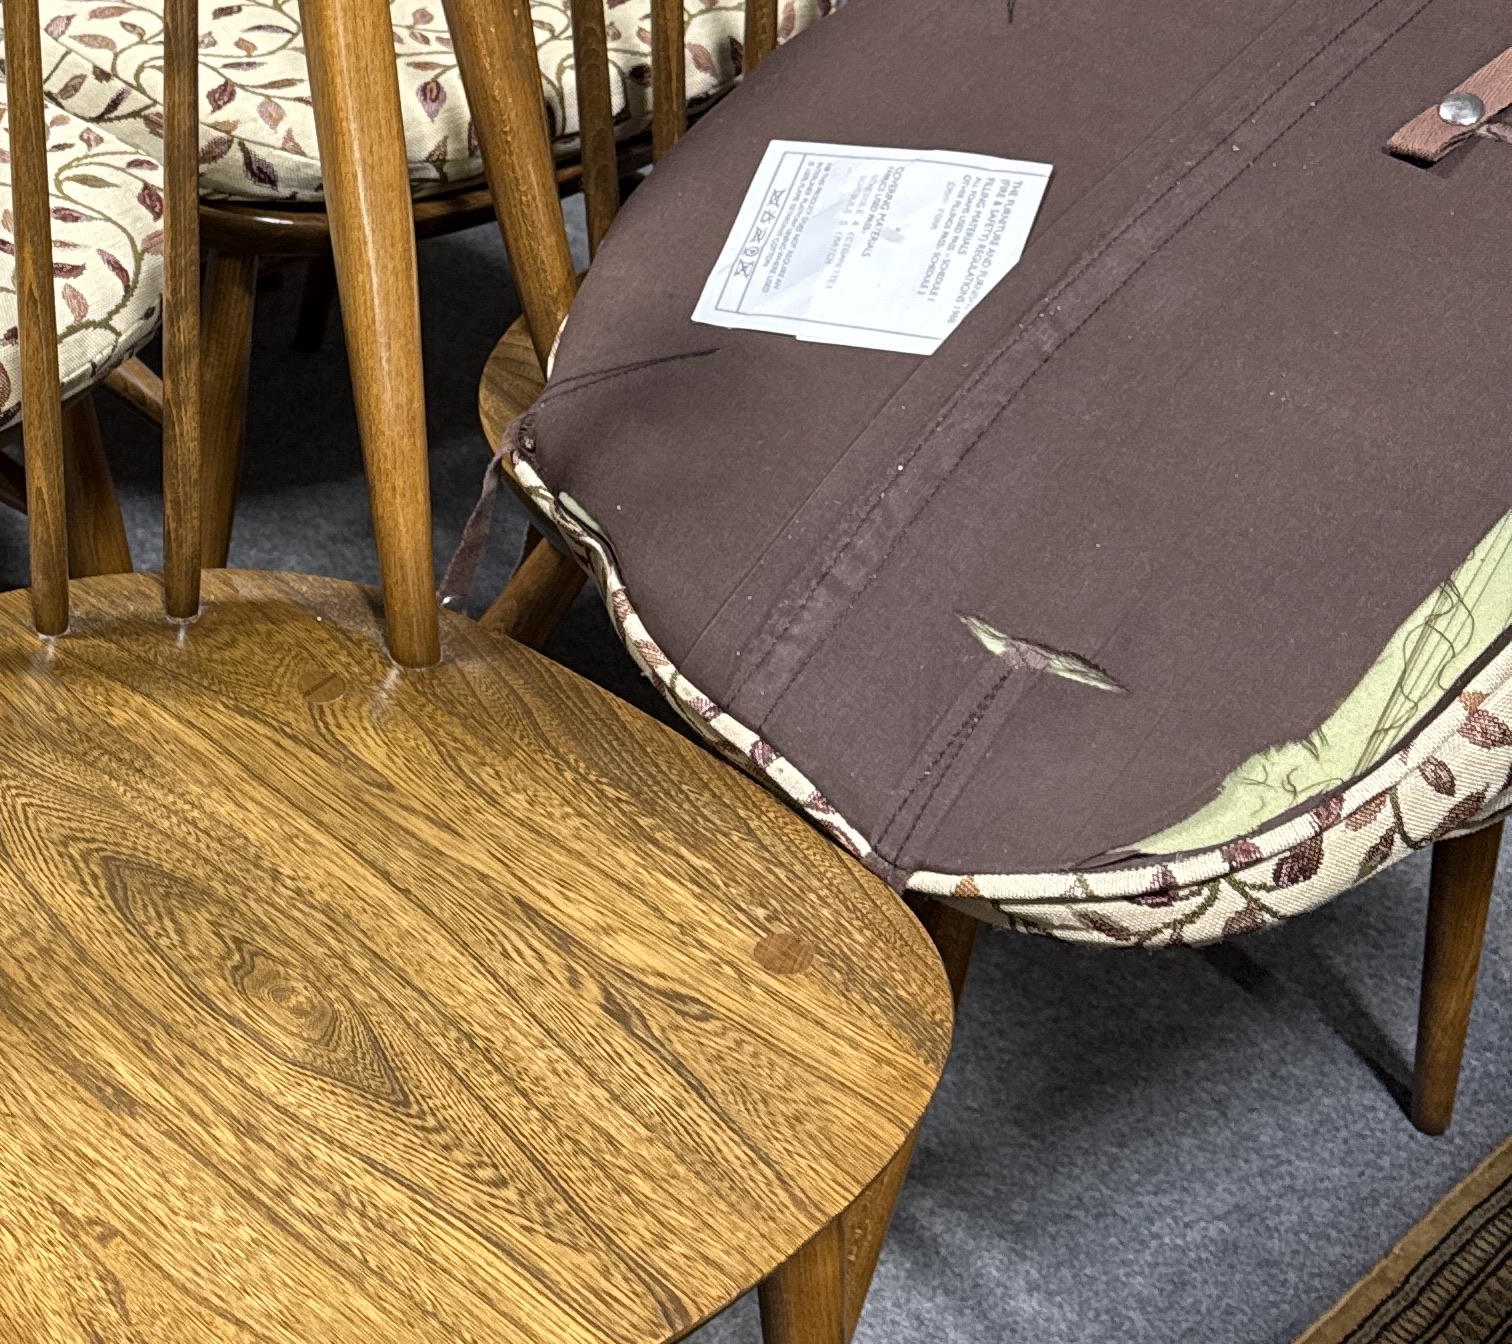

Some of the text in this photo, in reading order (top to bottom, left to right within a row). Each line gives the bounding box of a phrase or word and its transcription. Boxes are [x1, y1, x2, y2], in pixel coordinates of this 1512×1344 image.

[971, 176, 983, 189] ALL
[1007, 180, 1024, 198] THE
[860, 166, 906, 258] COVERING MATERIALS
[953, 215, 967, 234] USED
[956, 177, 996, 256] FILLING MATERIALS
[988, 198, 1016, 247] FURNITURE
[928, 258, 951, 297] SCHEDULE
[955, 243, 987, 303] REGULATIONS
[981, 247, 996, 269] AND
